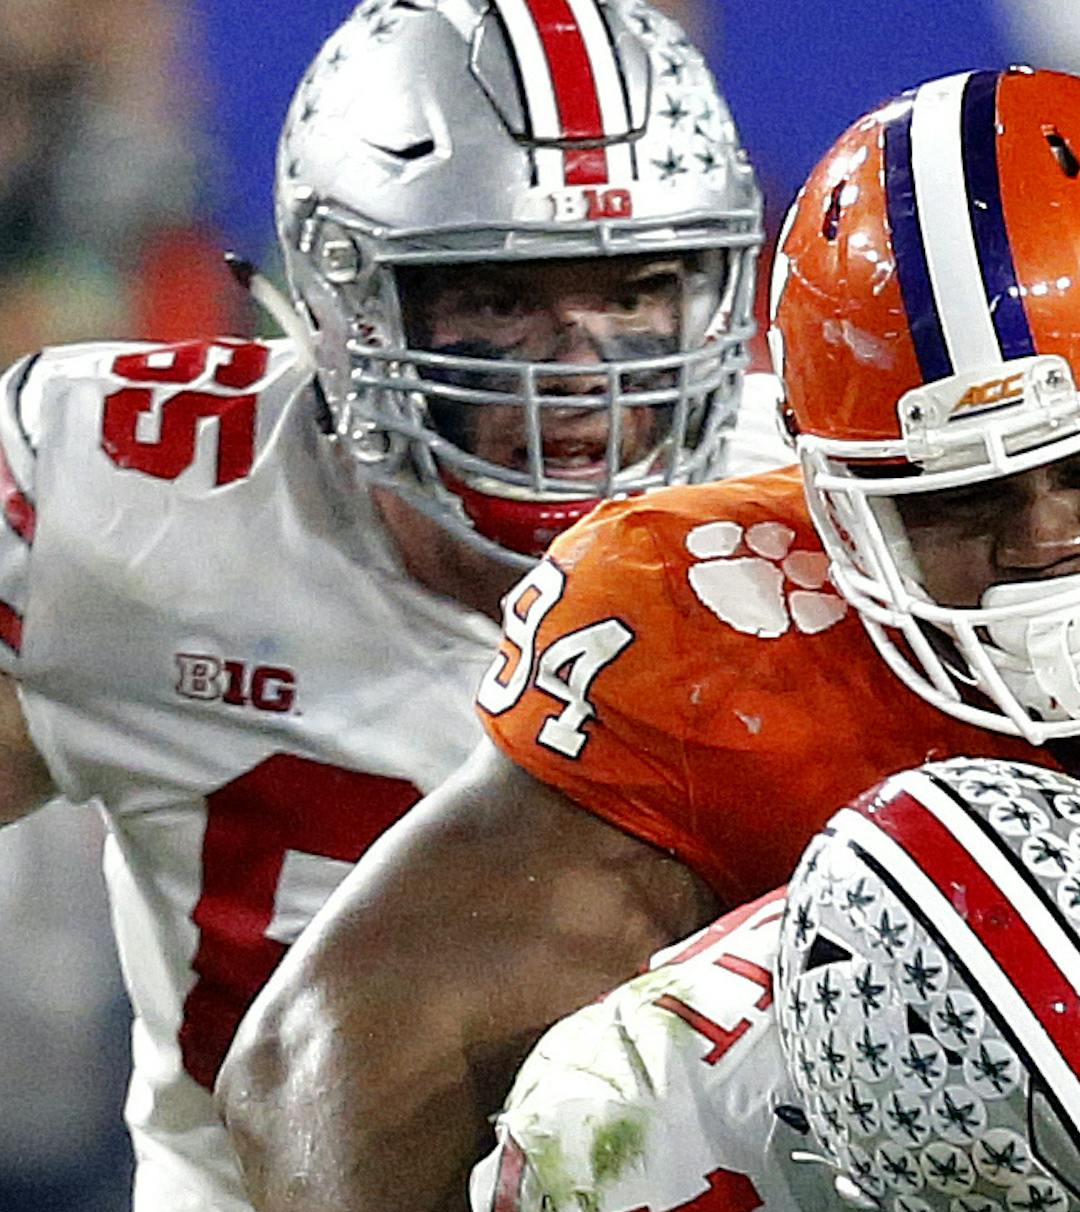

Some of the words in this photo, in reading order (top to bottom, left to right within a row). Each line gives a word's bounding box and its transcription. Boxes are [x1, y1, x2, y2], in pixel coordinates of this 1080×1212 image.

[101, 341, 271, 488] 65
[950, 371, 1025, 412] ACC
[475, 556, 636, 758] 94
